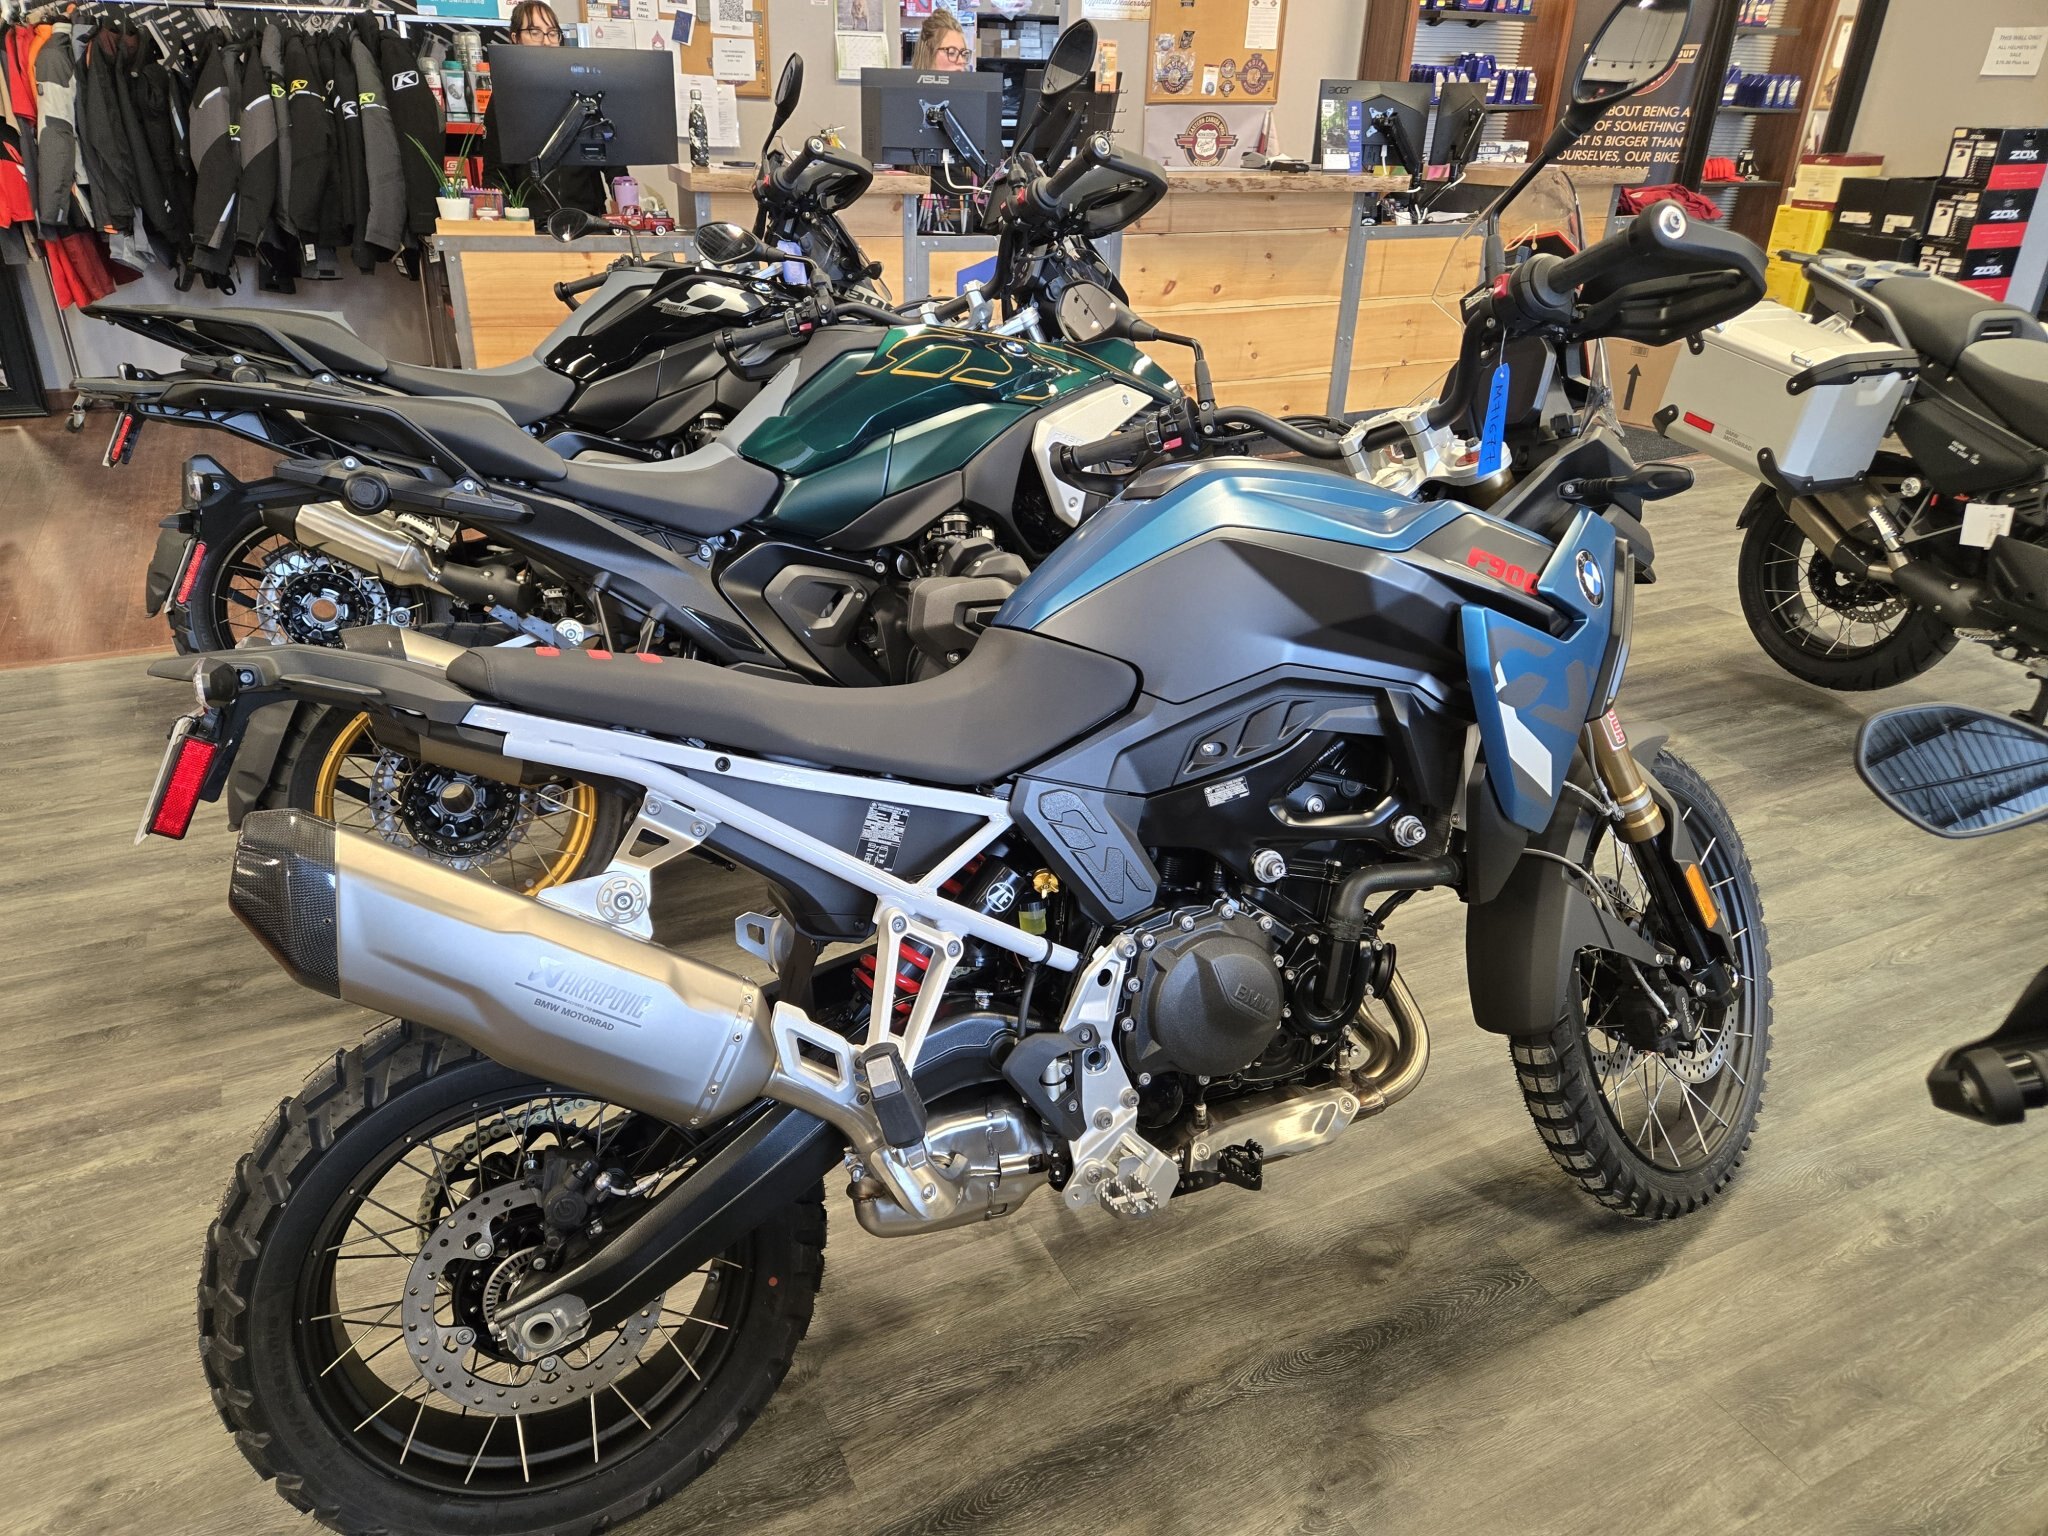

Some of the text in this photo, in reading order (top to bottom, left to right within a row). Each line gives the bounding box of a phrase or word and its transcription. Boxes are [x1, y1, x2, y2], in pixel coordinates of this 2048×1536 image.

[916, 74, 950, 85] ASUS
[1328, 85, 1352, 95] acer
[1605, 105, 1692, 118] BOUT BEING A
[1594, 120, 1686, 133] OF SOMETHING
[1572, 135, 1684, 148] AT IS BIGGER THAN
[1556, 149, 1681, 164] OURSELVES, OUR BIKE,
[2008, 149, 2040, 160] ZOX
[1988, 208, 2021, 220] ZOX
[1971, 264, 2003, 277] ZOX
[1722, 434, 1753, 452] MOTORRAD
[1233, 983, 1275, 1015] BMW
[533, 997, 615, 1031] BMW MOTORRAD
